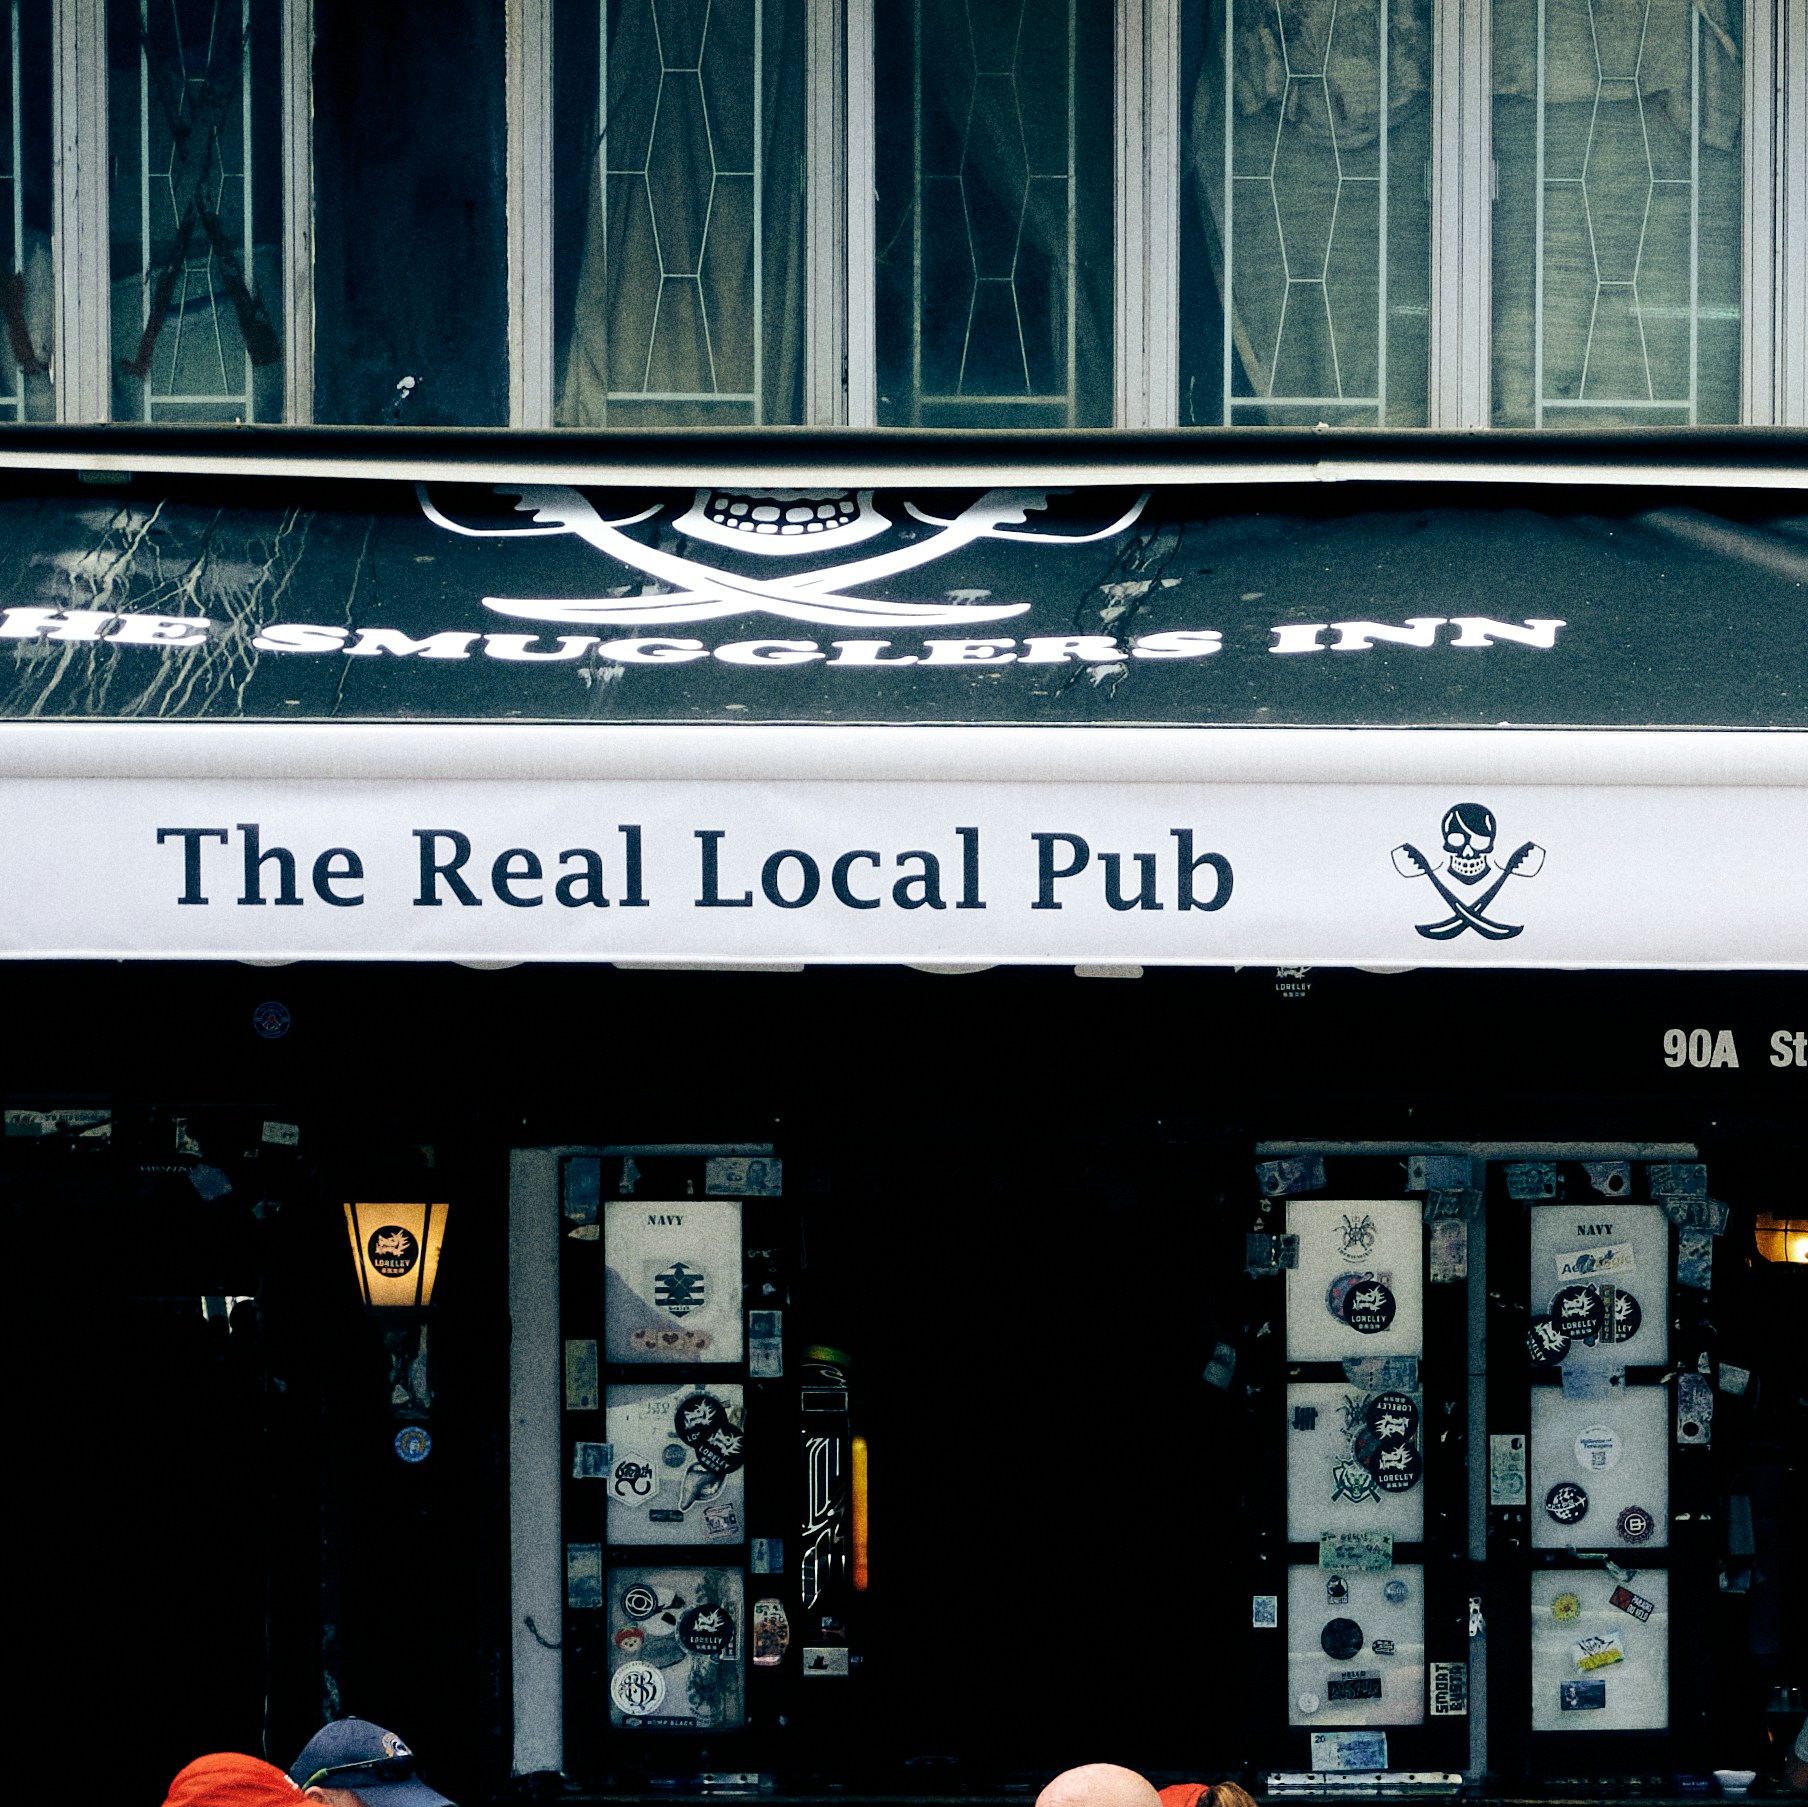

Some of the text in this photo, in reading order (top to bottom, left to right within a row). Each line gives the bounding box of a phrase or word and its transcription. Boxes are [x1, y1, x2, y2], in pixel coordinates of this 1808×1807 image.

[252, 623, 1223, 666] SMUGGLERS
[1268, 616, 1567, 655] INN
[155, 825, 1235, 913] The Real Local Pub
[1664, 1029, 1741, 1069] 90A
[647, 1215, 685, 1227] NAVY
[1576, 1223, 1614, 1236] NAVY
[1350, 1315, 1388, 1324] LORELEY
[1561, 1318, 1598, 1331] LORELEY
[1378, 1472, 1415, 1483] LORELEY
